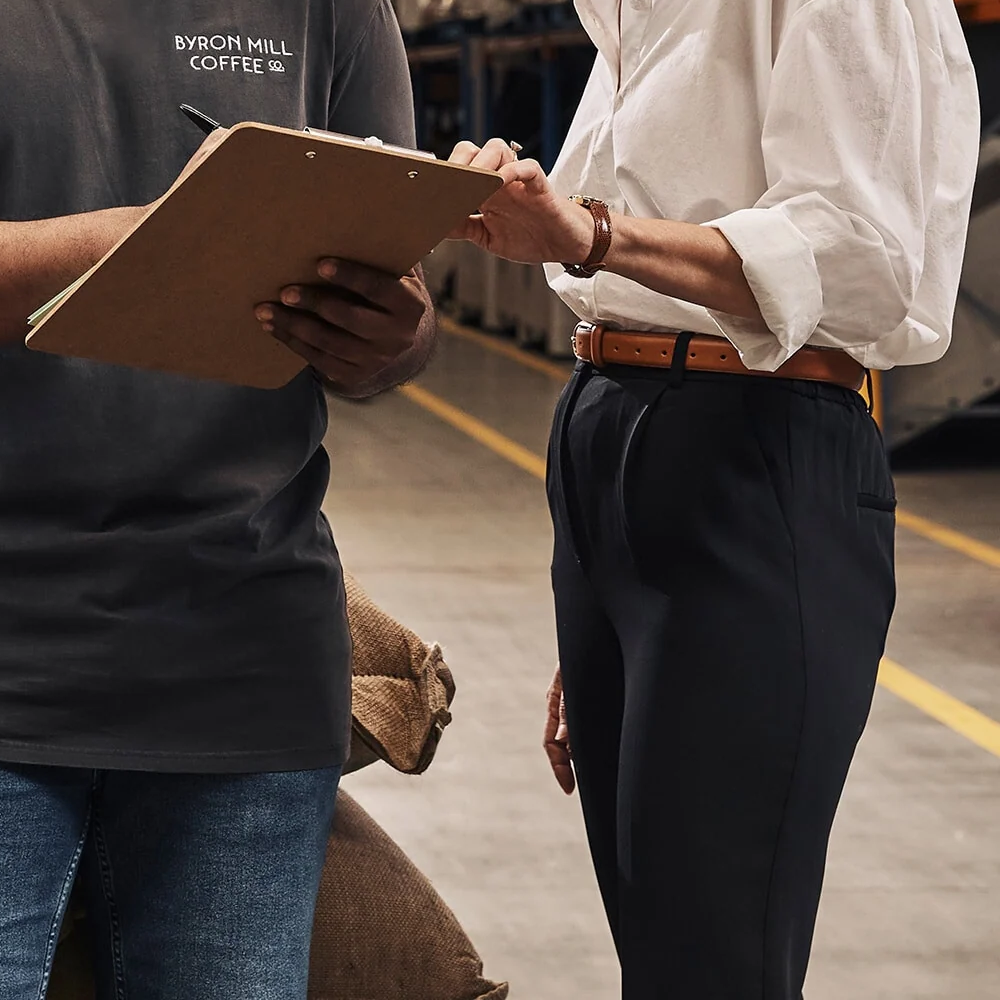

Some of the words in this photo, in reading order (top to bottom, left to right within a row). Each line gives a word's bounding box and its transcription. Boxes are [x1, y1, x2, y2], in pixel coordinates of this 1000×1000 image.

[174, 34, 242, 51] BYRON
[247, 36, 294, 56] MILL
[189, 55, 265, 75] COFFEE
